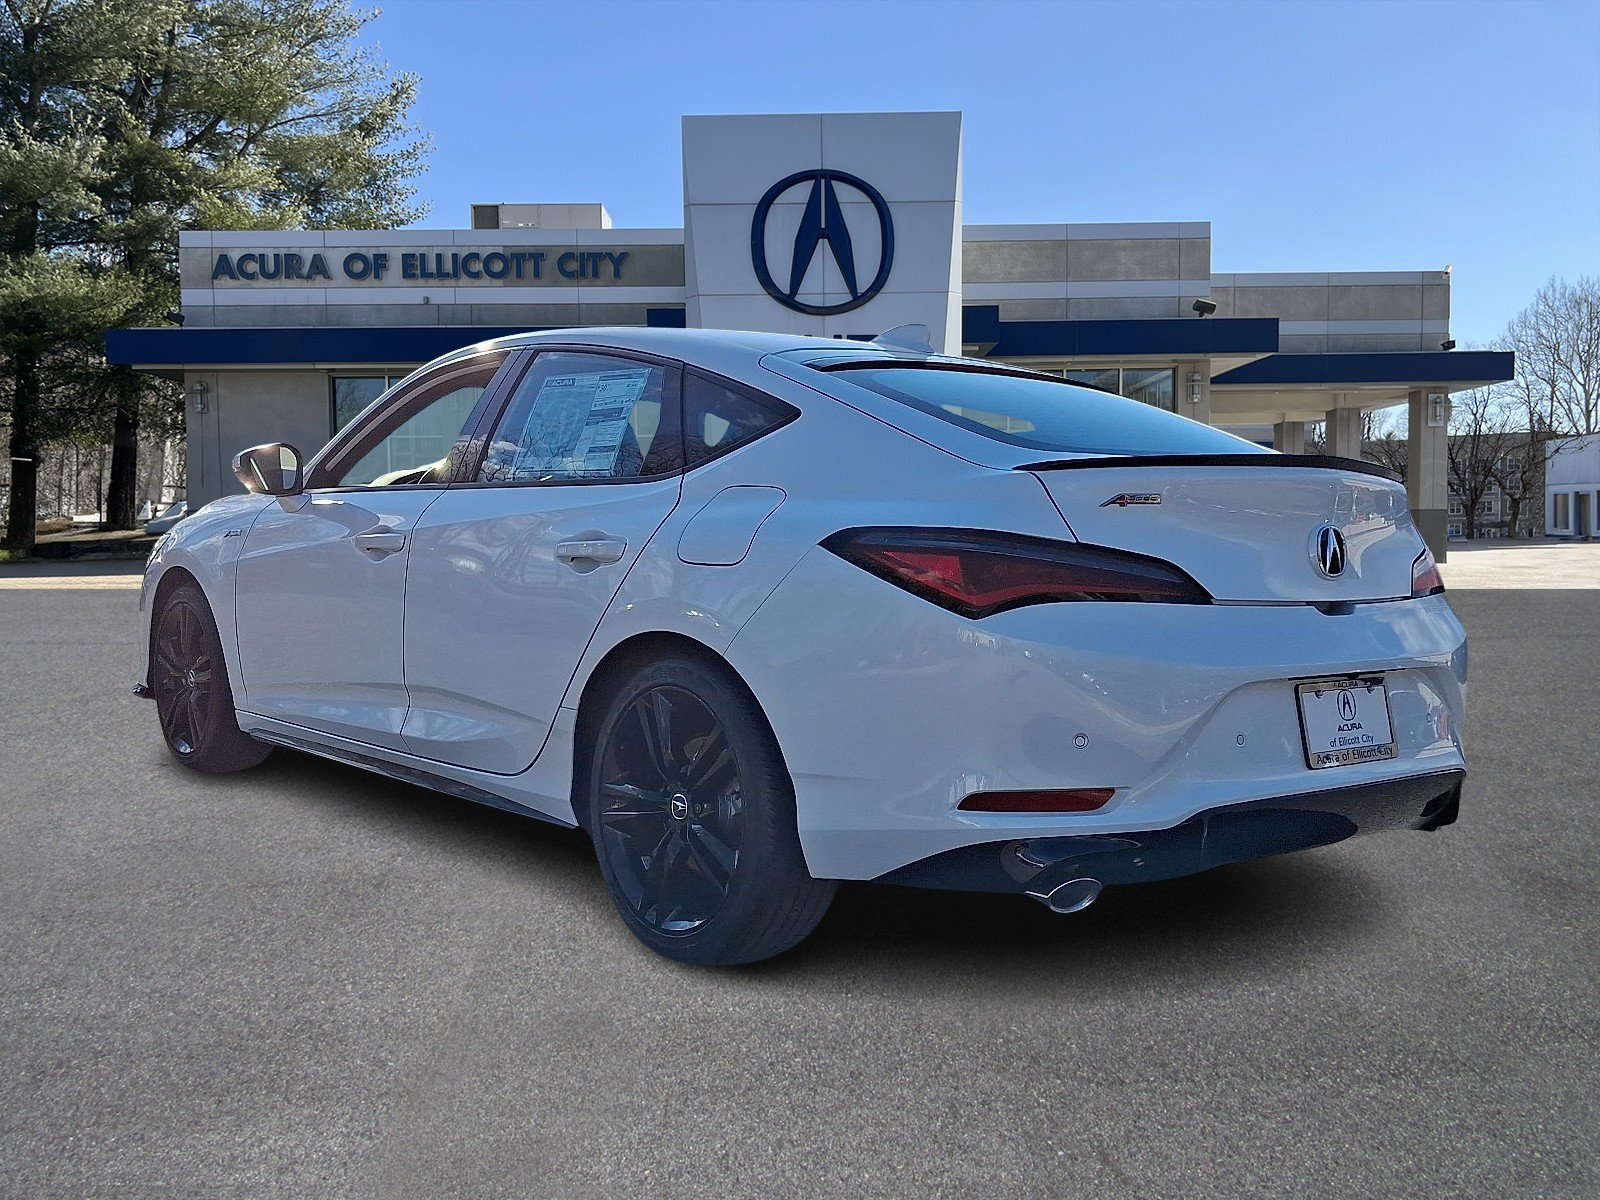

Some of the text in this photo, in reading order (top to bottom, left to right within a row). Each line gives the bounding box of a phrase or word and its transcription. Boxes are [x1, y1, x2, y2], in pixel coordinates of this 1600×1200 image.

[211, 251, 630, 280] ACURA OF ELLICOTT CITY
[1338, 723, 1363, 732] ACURA
[1329, 733, 1374, 748] of Ellicott City
[1317, 746, 1393, 765] Acura of Ellicott City
